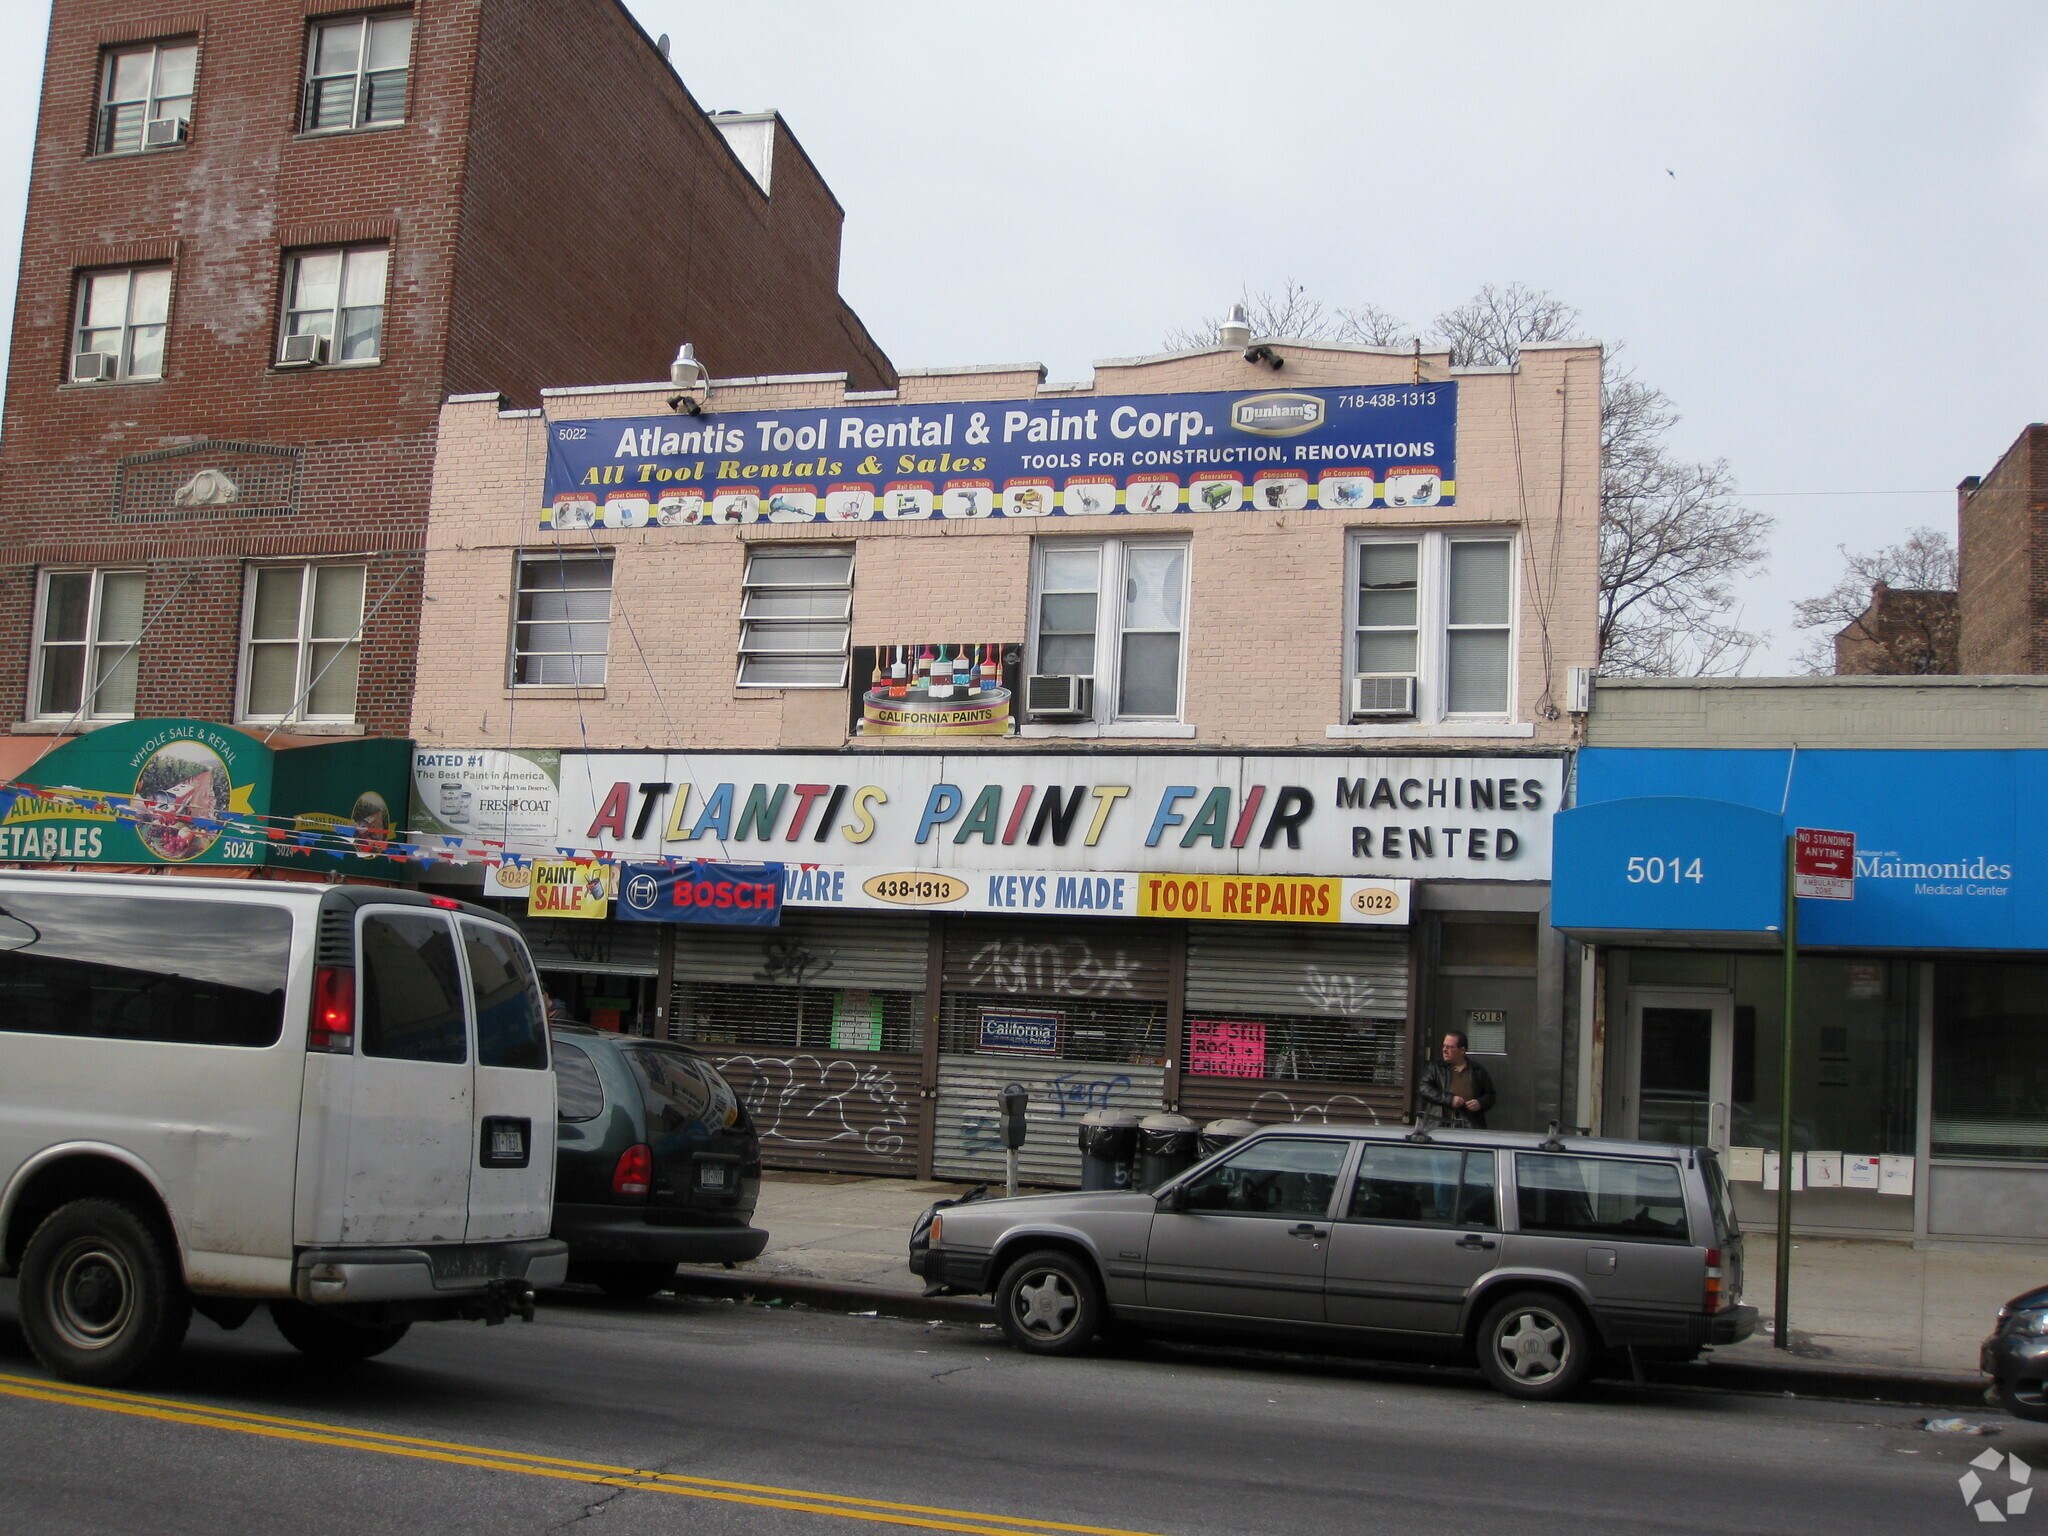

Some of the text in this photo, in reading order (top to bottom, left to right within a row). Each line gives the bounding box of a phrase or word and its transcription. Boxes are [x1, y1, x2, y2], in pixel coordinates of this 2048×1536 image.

[1338, 392, 1436, 408] 718-438-1313
[559, 428, 587, 441] 5022
[615, 405, 1213, 458] Atlantis Tool Rental & Paint Corp.
[1021, 442, 1435, 469] TOOLS FOR CONSTRUCTION, RENOVATIONS
[580, 452, 987, 486] All Tool Rentals & Sales
[1200, 472, 1233, 480] Generators
[1262, 471, 1300, 479] Compactors
[1333, 470, 1371, 478] Compressor
[1410, 467, 1439, 475] Machines
[975, 480, 990, 488] Tools
[1067, 477, 1090, 485] Sanders
[1097, 476, 1115, 485] Edger
[626, 491, 648, 499] Cleaners
[661, 489, 703, 498] Gardening Tools
[715, 488, 740, 496] Pressure
[842, 484, 861, 492] Pumps
[878, 709, 992, 724] CALIFORNIA PAINTS
[130, 726, 237, 768] WHOLE SALE & RETAIL
[417, 755, 484, 767] RATED #1
[416, 770, 545, 781] The Best Paint in America
[1335, 776, 1543, 811] MACHINES
[586, 782, 1316, 850] ATLANTIS PAINT FAIR
[1352, 825, 1520, 861] RENTED
[1799, 833, 1851, 847] NO STANDING
[223, 841, 254, 859] 5024
[1805, 846, 1845, 859] ANYTIME
[536, 866, 577, 884] PAINT
[1626, 856, 1704, 885] 5014
[1855, 856, 2012, 880] Maimonides
[501, 871, 529, 883] 5022
[1803, 879, 1845, 888] AMBULANCE
[673, 881, 775, 910] BOSCH
[877, 880, 950, 899] 438-1313
[988, 875, 1125, 910] KEYS MADE
[1815, 887, 1833, 895] ZONE
[1914, 883, 2008, 896] Medical Center
[535, 885, 583, 911] SALE
[1148, 880, 1330, 917] TOOL REPAIRS
[1357, 895, 1393, 909] 5022
[1472, 1012, 1502, 1022] 5018
[987, 1020, 1051, 1039] California
